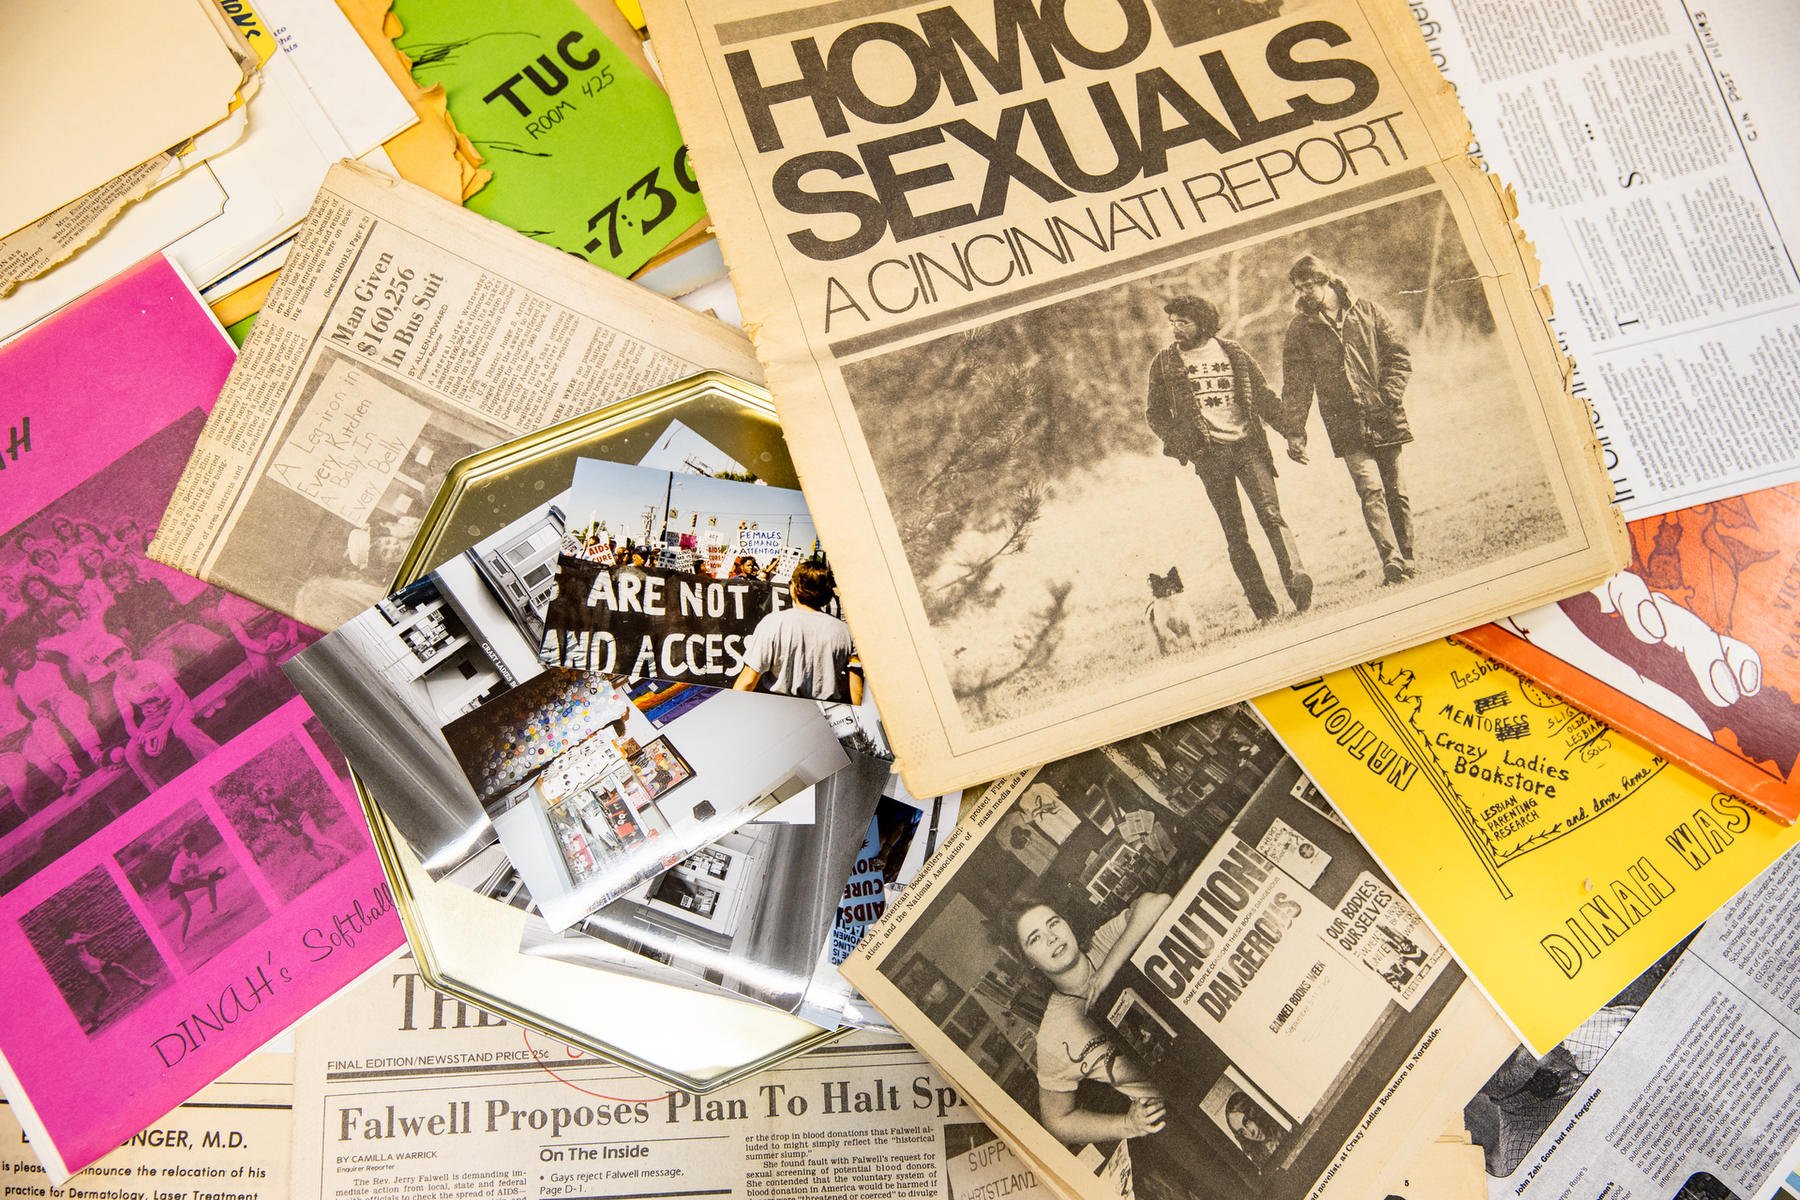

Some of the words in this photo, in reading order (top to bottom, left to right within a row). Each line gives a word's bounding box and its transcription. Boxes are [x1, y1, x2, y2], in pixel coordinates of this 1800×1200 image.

[482, 30, 600, 118] TUC
[723, 0, 1151, 153] HOMO
[525, 100, 577, 140] ROOM
[581, 64, 615, 100] 425
[771, 20, 1381, 262] SEXUALS
[823, 274, 871, 334] A
[868, 190, 1187, 306] CINCINNATI
[1186, 111, 1412, 223] REPORT
[331, 306, 366, 345] Man
[354, 252, 393, 301] Given
[357, 267, 414, 356] $160,256
[412, 273, 443, 310] Suit
[393, 312, 424, 346] Bus
[406, 364, 418, 377] BY
[415, 338, 431, 365] ALLEN
[427, 304, 448, 339] HOWARD
[381, 345, 407, 369] In
[271, 459, 302, 486] A
[290, 391, 347, 454] Leg-iron
[342, 368, 361, 386] in
[297, 454, 344, 499] Every
[325, 399, 372, 450] Kitchen
[329, 455, 365, 488] Baby
[351, 432, 376, 454] In
[367, 436, 407, 474] Belly
[588, 543, 610, 557] AIDS
[739, 531, 782, 540] FEMALES
[586, 569, 666, 616] ARE
[680, 581, 749, 620] NOT
[482, 642, 498, 661] CRAZY
[495, 660, 512, 681] LADIES
[540, 629, 617, 675] AND
[1450, 658, 1504, 689] Lesbia
[1548, 706, 1577, 728] SLIG
[1567, 714, 1592, 733] OLDE
[1436, 732, 1487, 764] Crazy
[1503, 750, 1570, 782] Ladies
[1454, 757, 1556, 799] Bookstore
[969, 796, 990, 821] protect
[990, 777, 1007, 794] First
[977, 809, 993, 827] mass
[992, 789, 1011, 809] media
[1008, 775, 1021, 789] ads
[1480, 795, 1517, 822] LESBIAN
[1487, 798, 1538, 832] PARENTING
[1566, 807, 1589, 828] and
[1593, 791, 1621, 813] down
[1621, 767, 1651, 792] home
[1493, 811, 1540, 842] RESEARCH
[864, 939, 885, 961] ation,
[882, 922, 897, 939] and
[894, 909, 908, 923] the
[906, 880, 932, 910] National
[933, 842, 965, 879] Association
[963, 831, 973, 841] of
[880, 892, 909, 925] American
[909, 851, 942, 890] Booksellers
[943, 827, 963, 850] Associ-
[1540, 856, 1675, 980] DINAH
[1665, 791, 1752, 872] WAS
[303, 882, 396, 962] Softball
[845, 901, 885, 924] AIDS
[1143, 840, 1276, 999] CAUTION!
[1326, 917, 1349, 939] OUR
[1339, 890, 1392, 951] OURSELVES
[1183, 989, 1197, 1005] SOME
[1194, 967, 1213, 989] PEOPLE
[1228, 926, 1242, 942] THESE
[1240, 908, 1256, 926] BOOKS
[1197, 893, 1301, 1023] DANGEROUS
[1289, 980, 1311, 1006] BOOKS
[1305, 960, 1326, 981] WEEK
[327, 1060, 363, 1070] FINAL
[366, 1052, 493, 1069] EDITION/NEWSSTAND
[495, 1050, 530, 1061] PRICE
[338, 1101, 471, 1141] Falwell
[484, 1098, 649, 1139] Proposes
[665, 1090, 748, 1124] Plan
[759, 1083, 808, 1118] To
[820, 1078, 901, 1115] Halt
[1318, 1163, 1341, 1193] novelist,
[1339, 1151, 1348, 1162] at
[1344, 1129, 1365, 1153] Crazy
[1357, 1106, 1381, 1130] Ladies
[1379, 1071, 1407, 1106] Bookstore
[1405, 1061, 1415, 1071] in
[1412, 1028, 1441, 1062] Northside.
[1605, 1113, 1629, 1142] Cincinnati
[1626, 1094, 1644, 1114] lesbian
[1643, 1065, 1667, 1093] community
[202, 1131, 248, 1149] M.D.
[337, 1156, 349, 1164] BY
[351, 1153, 393, 1163] CAMILLA
[395, 1150, 438, 1160] WARRICK
[539, 1148, 564, 1162] On
[567, 1147, 597, 1162] The
[602, 1145, 650, 1160] Inside
[1515, 1179, 1530, 1196] John
[1527, 1163, 1542, 1179] Zeh:
[1540, 1145, 1556, 1162] Gone
[1554, 1132, 1566, 1144] but
[1565, 1119, 1576, 1132] not
[1574, 1088, 1601, 1119] forgotten
[2, 1161, 10, 1172] is
[14, 1162, 46, 1175] pleas
[81, 1166, 132, 1177] nnounce
[137, 1166, 157, 1177] the
[161, 1166, 226, 1178] relocation
[230, 1166, 246, 1178] of
[248, 1167, 266, 1179] his
[366, 1163, 395, 1172] Reporter
[539, 1184, 562, 1197] Page
[550, 1172, 573, 1185] Gays
[576, 1170, 604, 1184] reject
[606, 1168, 639, 1181] Falwell
[642, 1168, 685, 1182] message,
[5, 1185, 45, 1199] practice
[50, 1186, 65, 1198] for
[69, 1188, 148, 1200] Dermatology,
[153, 1190, 187, 1200] Laser
[192, 1191, 259, 1200] Treatment
